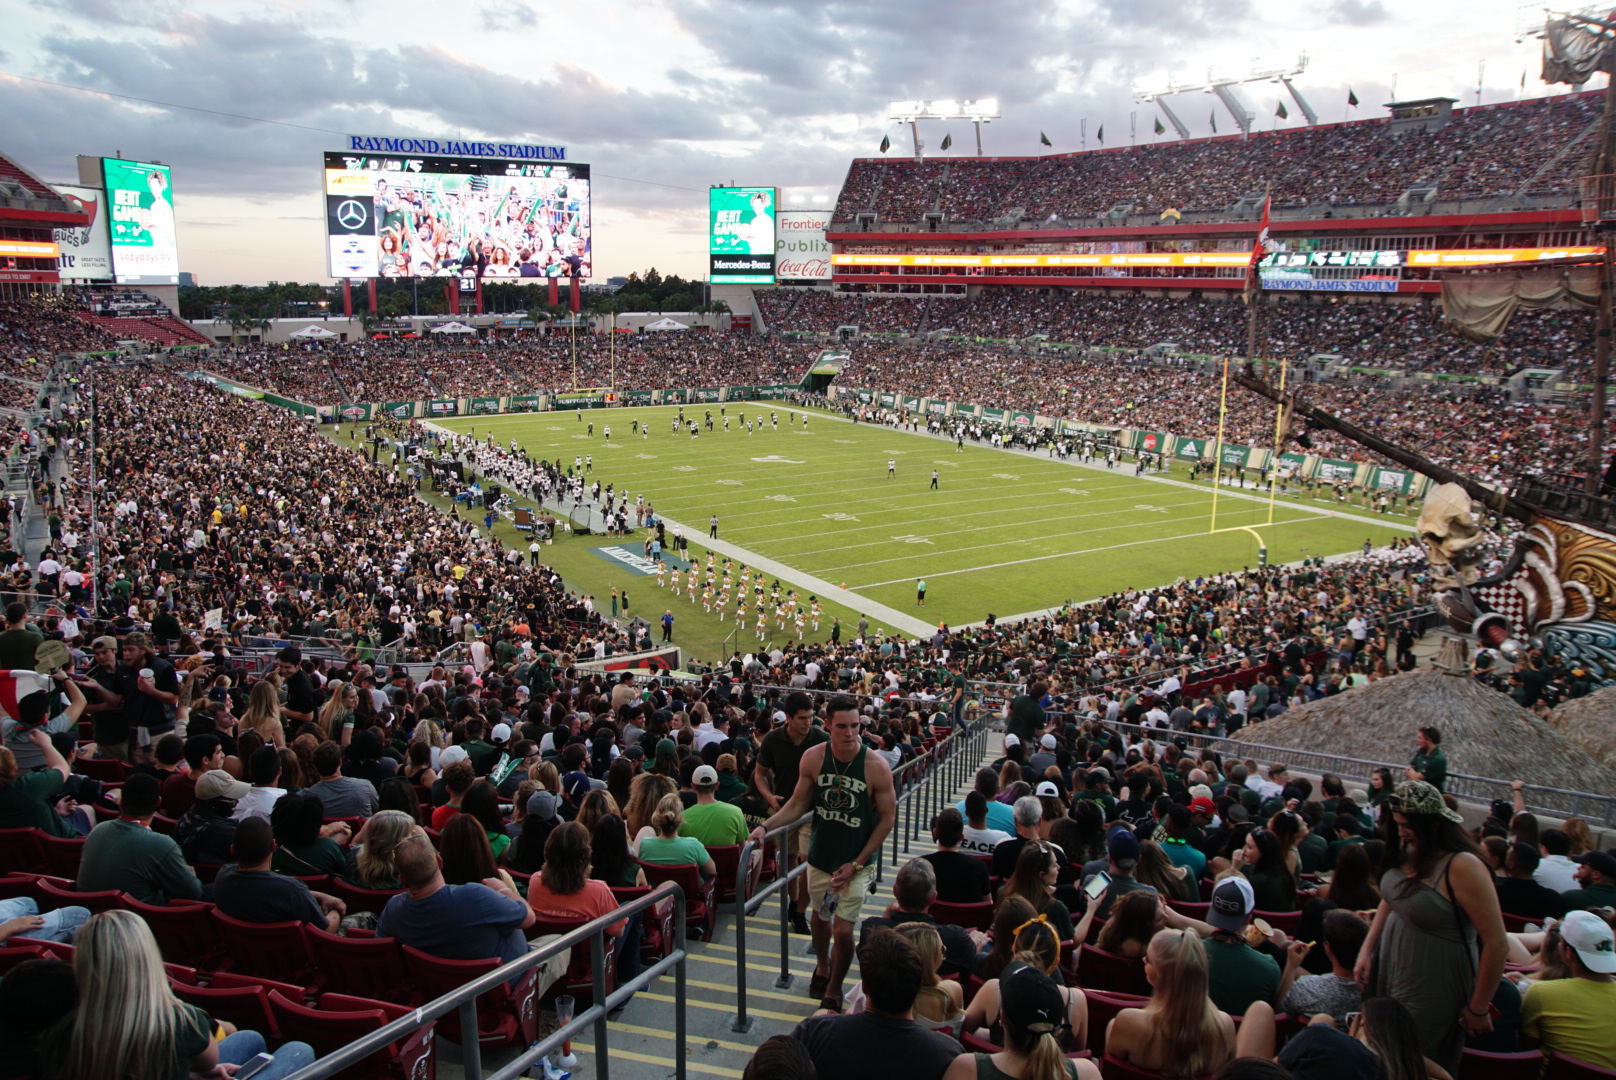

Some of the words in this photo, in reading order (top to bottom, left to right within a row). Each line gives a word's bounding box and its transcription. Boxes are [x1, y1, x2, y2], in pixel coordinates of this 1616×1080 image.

[350, 135, 440, 154] RAYMOND
[441, 140, 496, 157] JAMES
[498, 143, 566, 160] STADIUM
[387, 161, 401, 170] 10
[781, 218, 827, 229] Frontier
[53, 230, 80, 248] BUCS
[776, 239, 829, 252] Publix
[120, 252, 159, 263] Lazydays
[160, 253, 172, 262] RV
[713, 260, 771, 270] Mercedes-Benz
[777, 258, 831, 277] Coca-Cola
[460, 278, 475, 290] 21
[1263, 281, 1312, 290] RAYMOND
[1312, 281, 1347, 291] JAMES
[1349, 281, 1397, 292] STADIUM
[557, 397, 603, 405] #USFFOOTALL
[816, 806, 861, 828] BULLS
[961, 838, 996, 853] EACE
